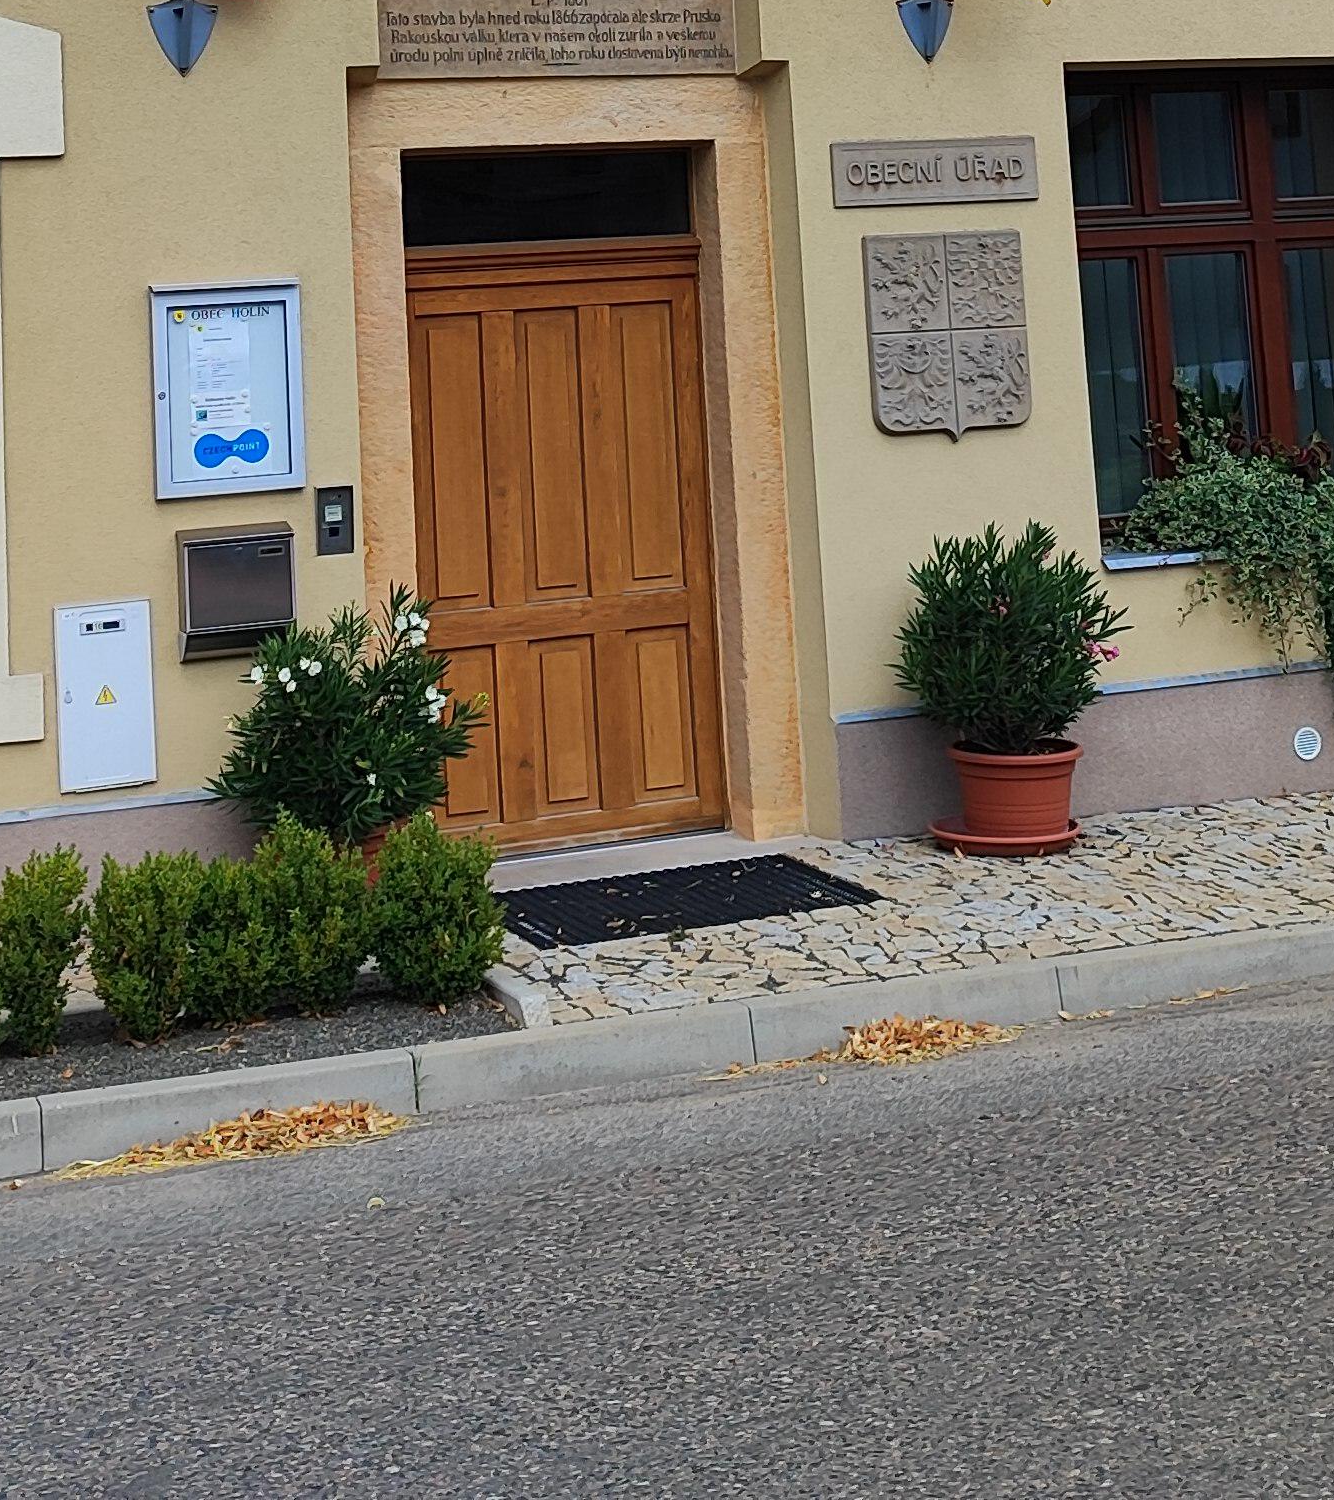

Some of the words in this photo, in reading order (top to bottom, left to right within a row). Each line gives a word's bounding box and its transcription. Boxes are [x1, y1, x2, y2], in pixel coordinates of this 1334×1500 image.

[386, 11, 410, 27] Tato
[412, 10, 455, 26] stavba
[458, 10, 486, 29] byla
[487, 10, 521, 26] hned
[523, 10, 550, 25] roku
[551, 9, 578, 25] 1866
[631, 10, 649, 24] ale
[649, 9, 681, 24] skrze
[683, 8, 721, 24] Prusko
[390, 28, 459, 45] Rakouskou
[550, 46, 576, 61] toho
[578, 46, 606, 60] roku
[847, 153, 944, 186] OBECNÍ
[954, 153, 1025, 182] ÚŘAD
[191, 308, 225, 320] OBEC
